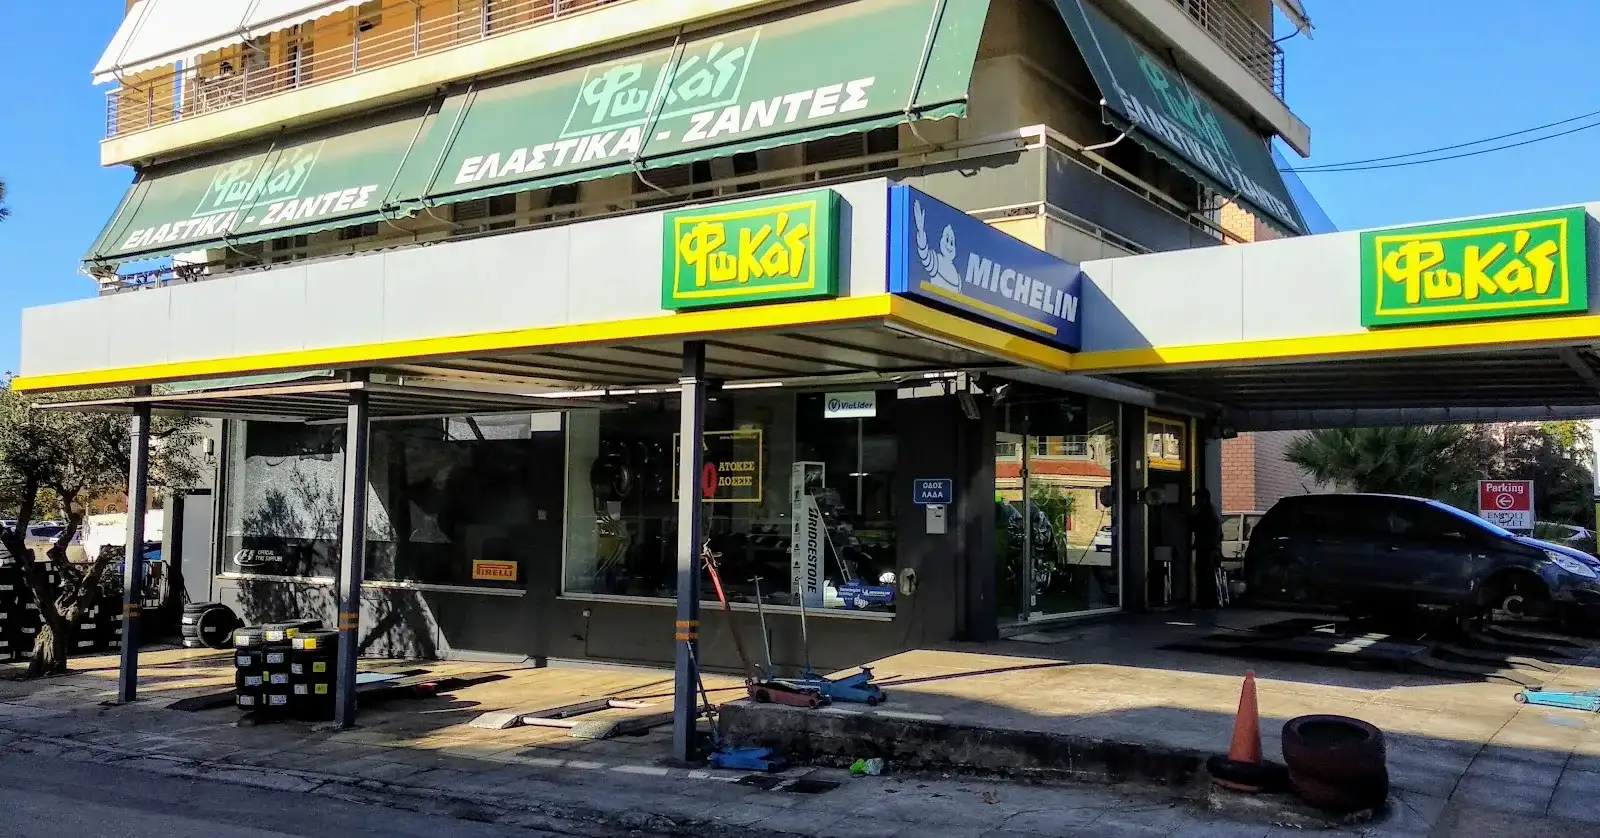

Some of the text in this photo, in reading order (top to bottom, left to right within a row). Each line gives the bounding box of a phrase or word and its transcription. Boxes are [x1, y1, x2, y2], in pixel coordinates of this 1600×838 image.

[453, 126, 645, 186] ΕΛΑΣΤΙΚΑ
[682, 76, 876, 143] ΖΑΝΤΕΣ
[120, 212, 240, 251] ΕΛΑΣΤΙΚΑ
[259, 184, 379, 227] ΖΑΝΤΕΣ
[965, 252, 1079, 324] MICHELIN
[718, 461, 755, 472] ΑΤΟΚΕΣ
[718, 476, 753, 487] ΔΟΣΕΙΣ
[1486, 483, 1524, 495] Parking
[476, 563, 514, 577] PIRELLI
[807, 506, 819, 594] BRIDGESTONE
